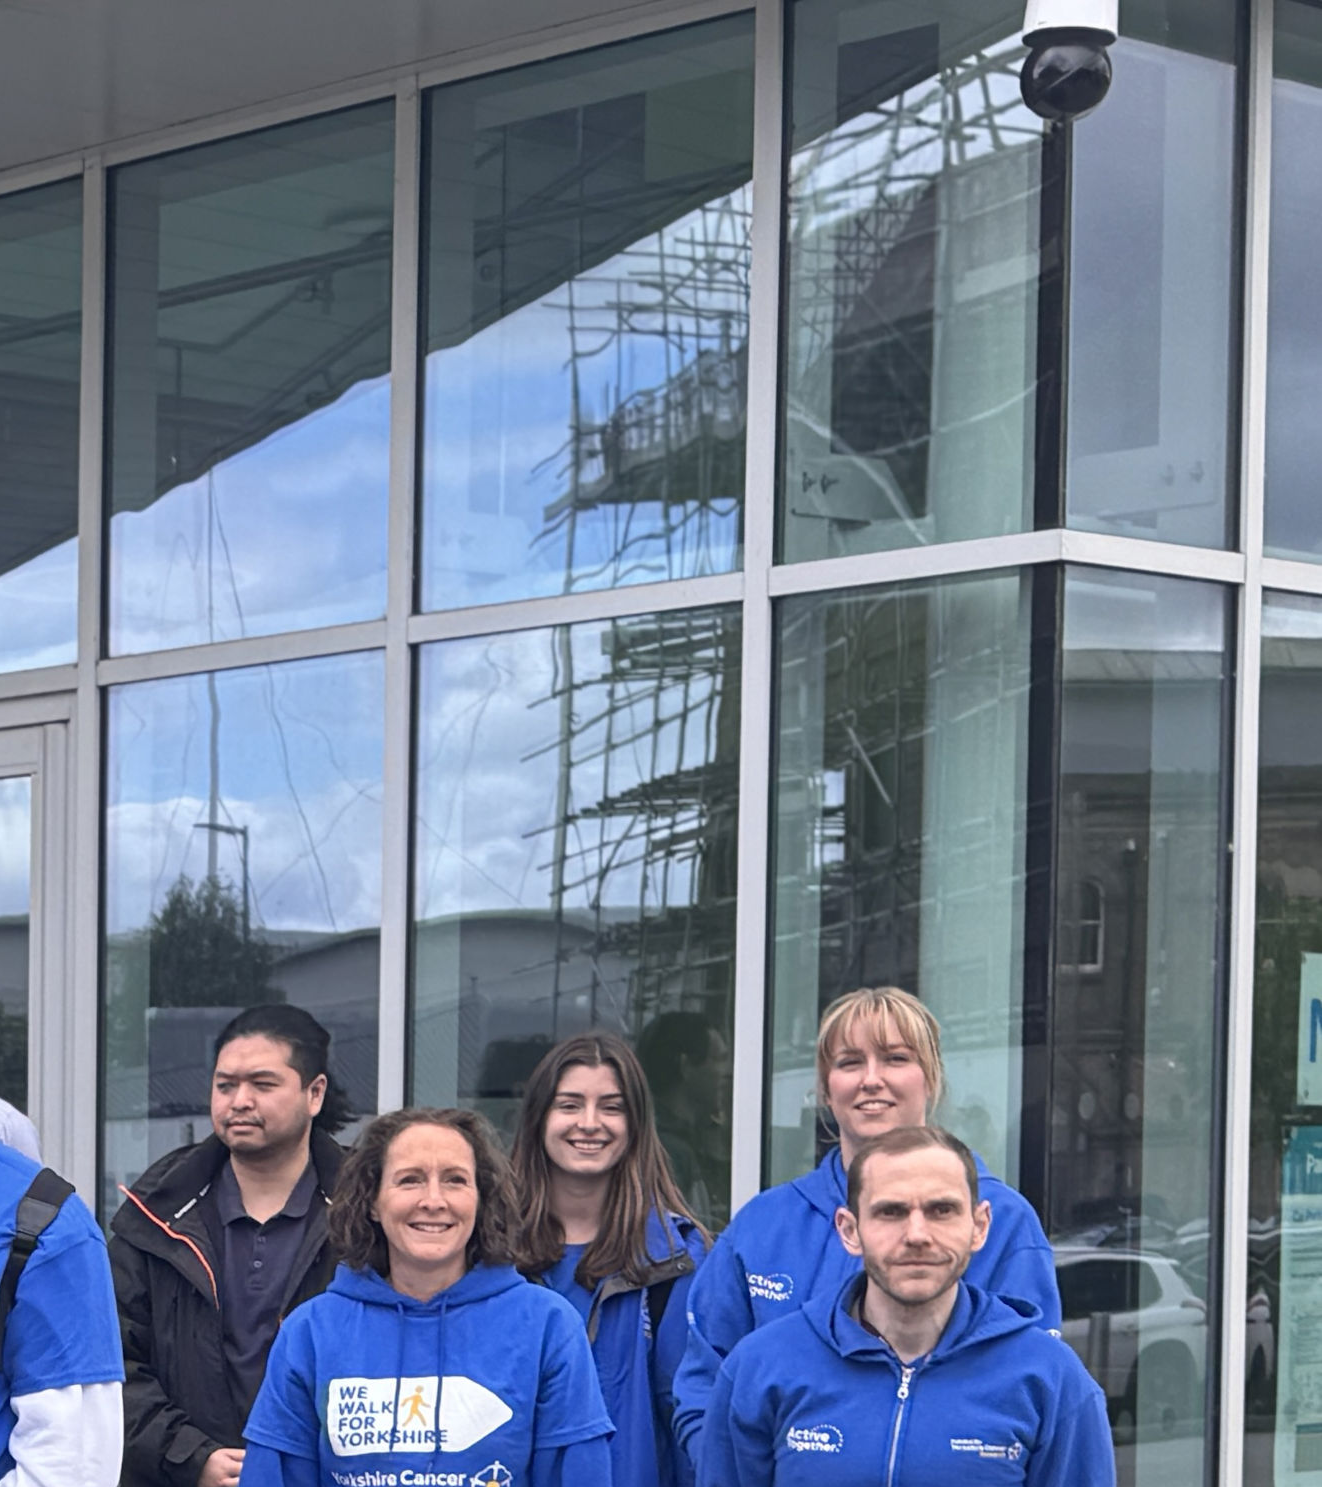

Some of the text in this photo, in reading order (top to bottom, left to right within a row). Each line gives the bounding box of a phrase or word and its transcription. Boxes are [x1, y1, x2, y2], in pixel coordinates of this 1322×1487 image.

[745, 1272, 784, 1291] ctive
[340, 1386, 368, 1400] WE
[338, 1400, 394, 1416] WALK
[338, 1416, 375, 1432] FOR
[337, 1429, 448, 1448] YORKSHIRE
[787, 1426, 830, 1442] Active
[331, 1469, 466, 1487] Yorkshire Cancer
